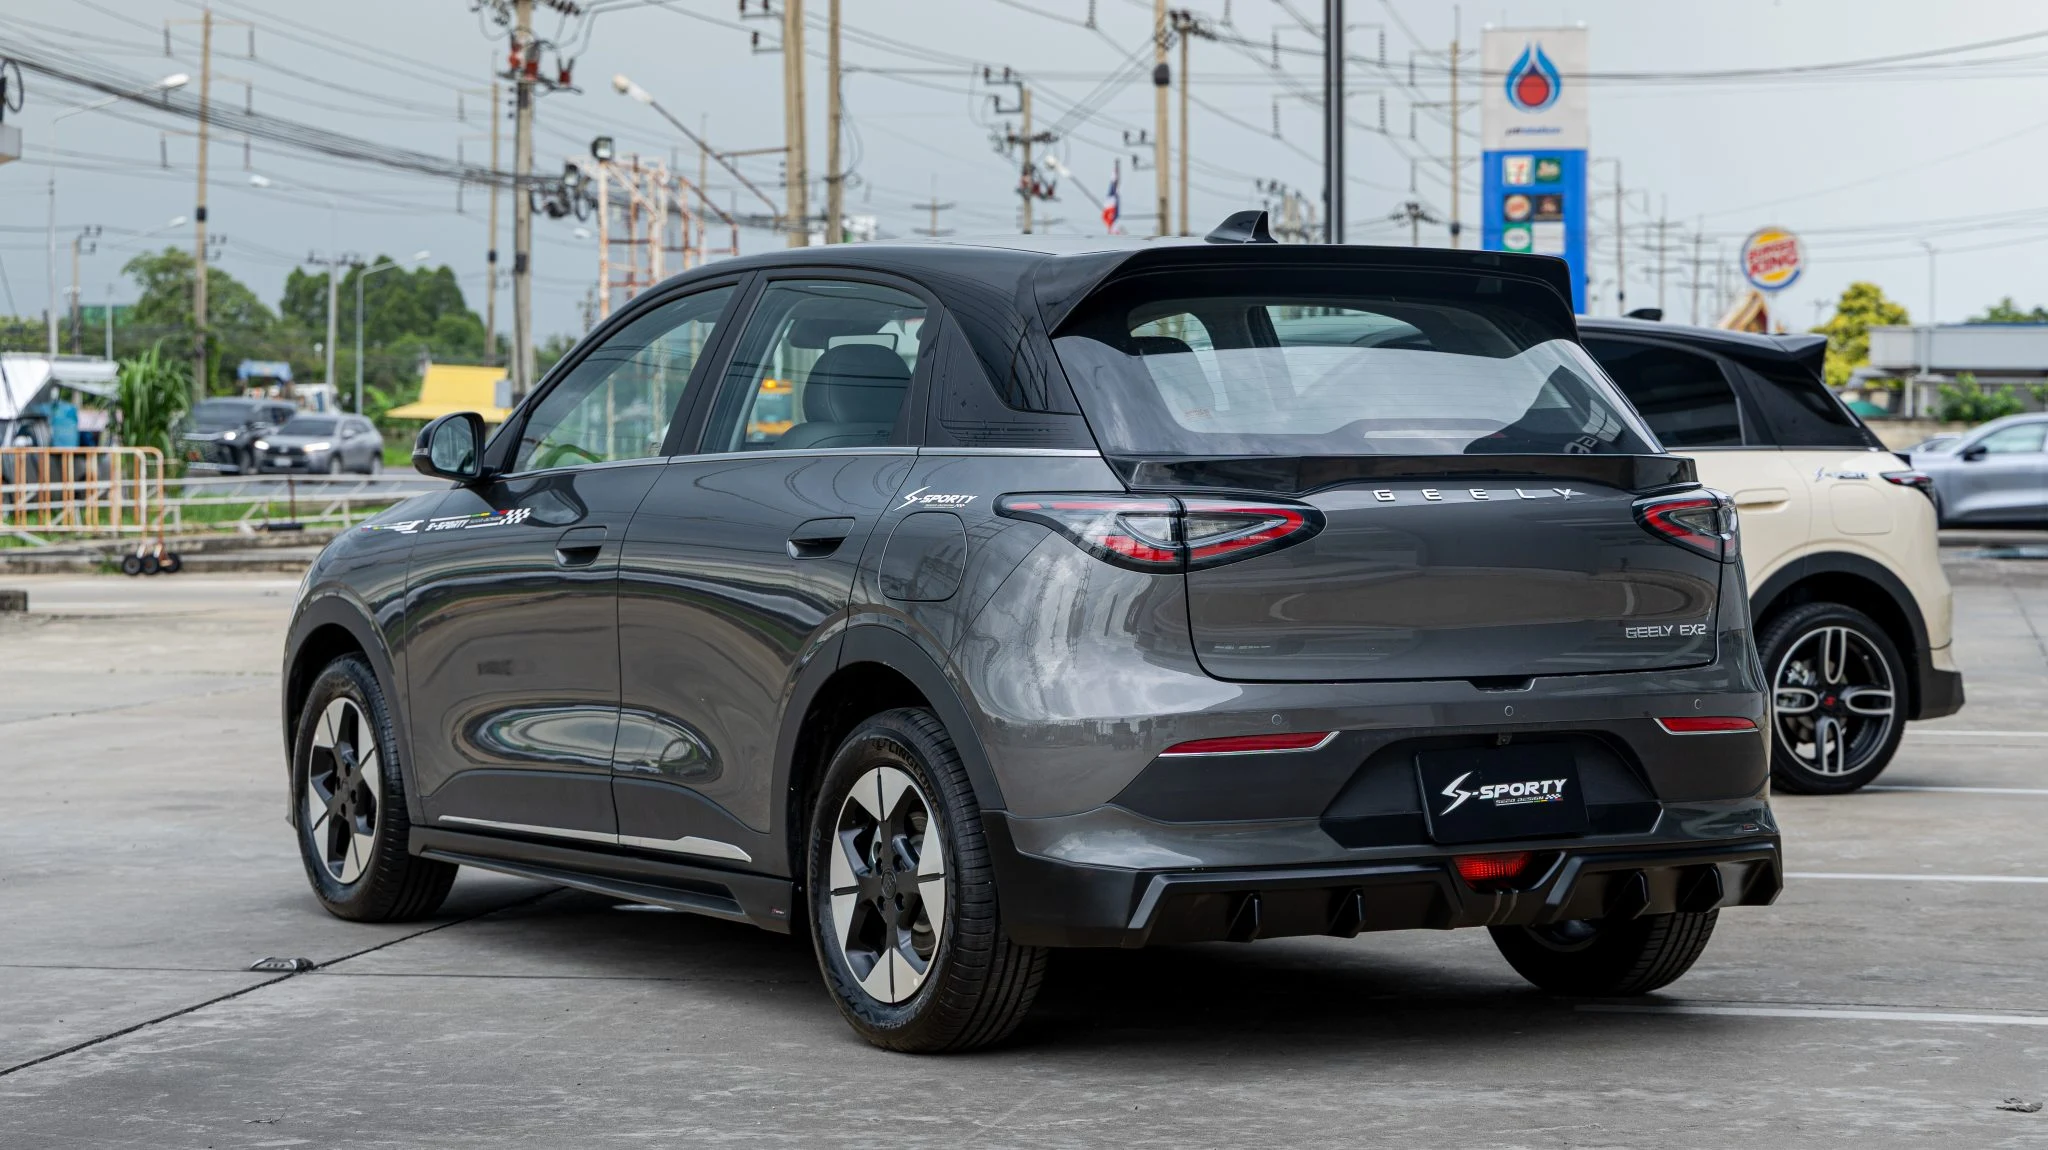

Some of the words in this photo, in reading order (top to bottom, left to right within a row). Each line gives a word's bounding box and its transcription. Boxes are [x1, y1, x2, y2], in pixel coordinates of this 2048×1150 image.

[1749, 255, 1799, 276] KING
[892, 485, 979, 511] S-SPORTY
[1372, 488, 1573, 502] GEELY
[1625, 625, 1674, 639] GEELY
[1679, 623, 1707, 636] EX2
[1438, 770, 1568, 816] S-SPORTY
